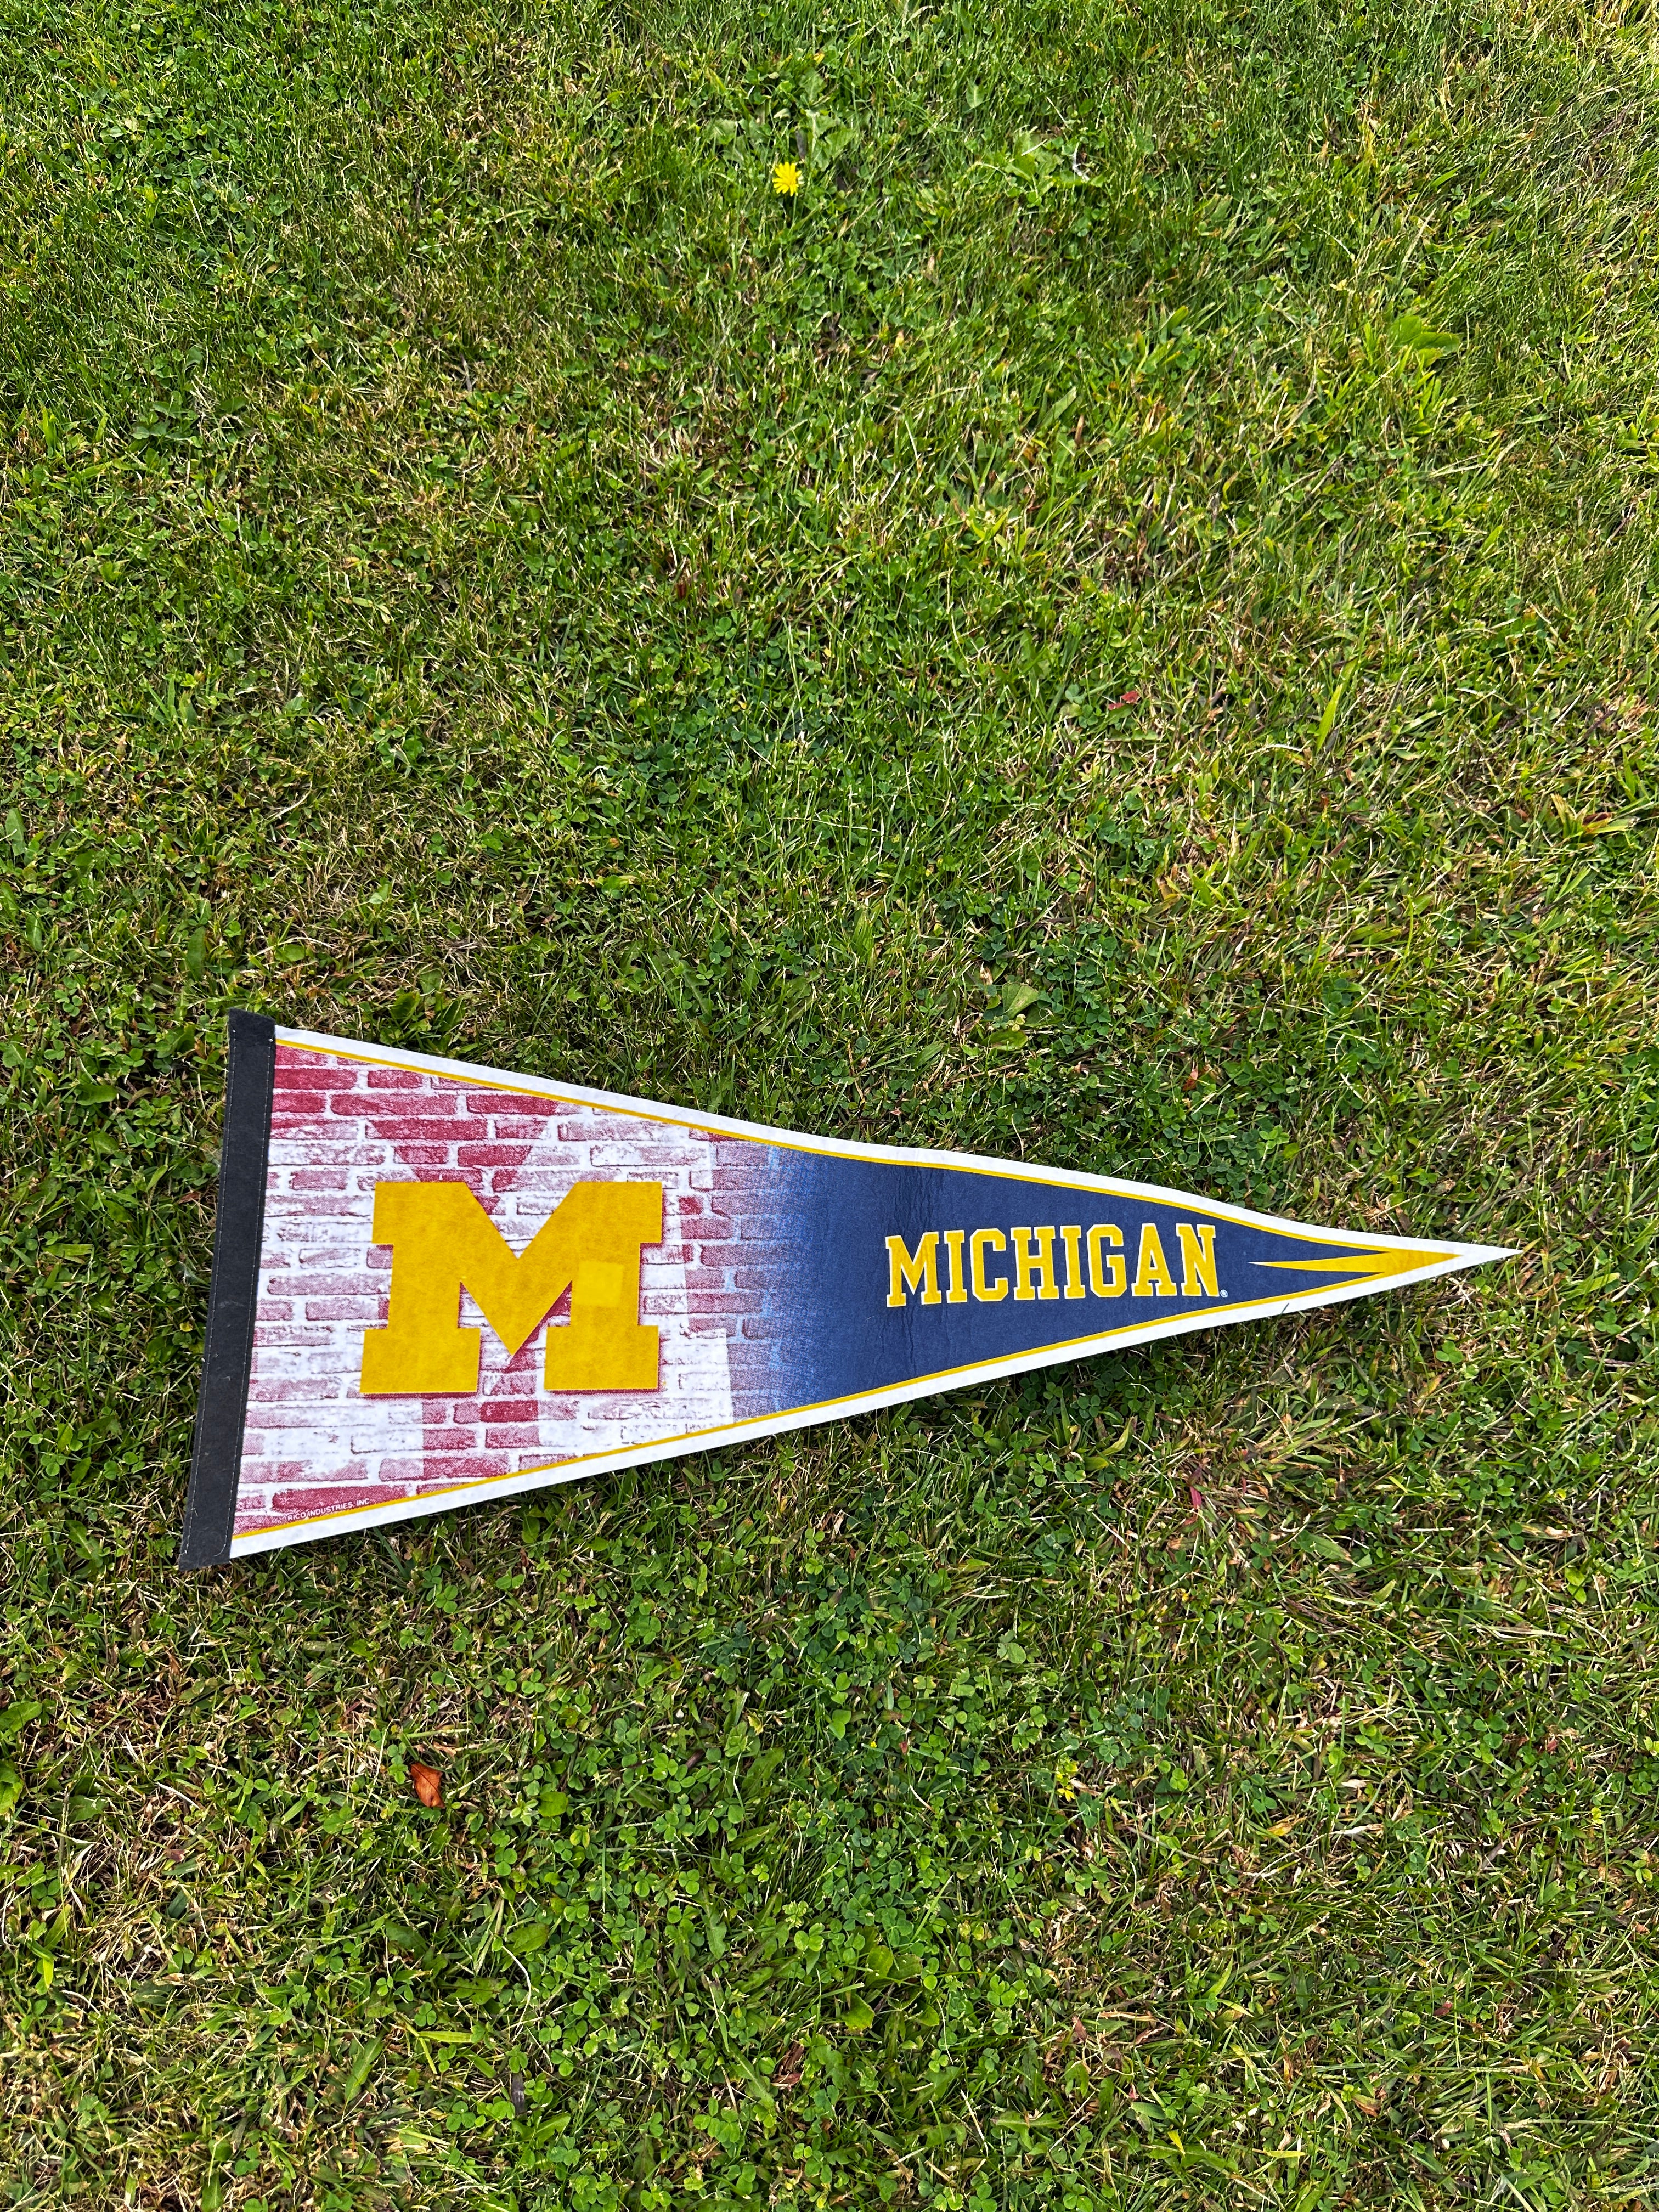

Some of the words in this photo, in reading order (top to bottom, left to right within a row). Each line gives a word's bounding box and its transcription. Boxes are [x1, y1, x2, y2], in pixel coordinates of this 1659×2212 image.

[360, 1181, 663, 1393] M
[885, 1223, 1220, 1307] MICHIGAN
[287, 1512, 306, 1521] RICO
